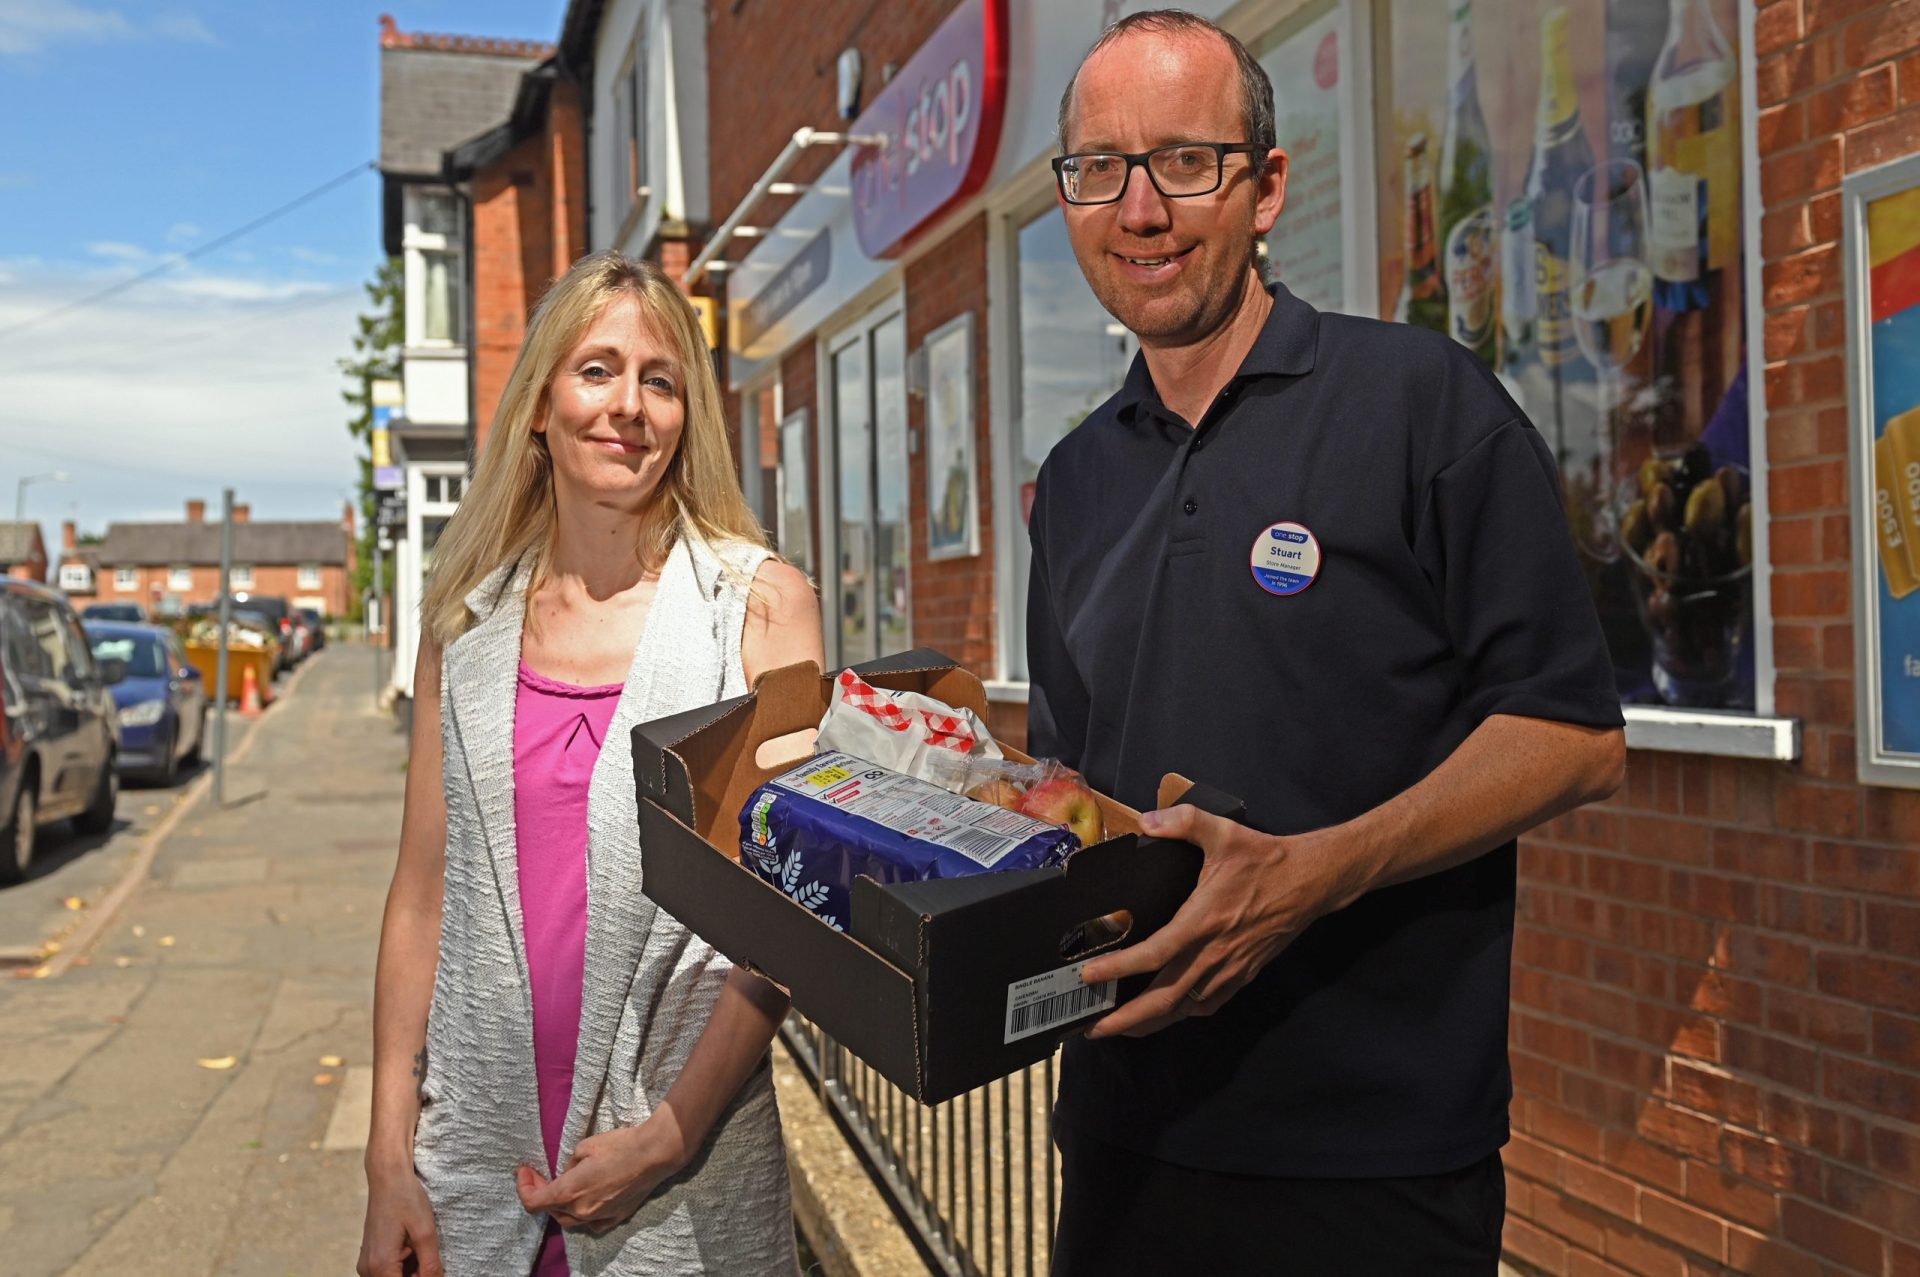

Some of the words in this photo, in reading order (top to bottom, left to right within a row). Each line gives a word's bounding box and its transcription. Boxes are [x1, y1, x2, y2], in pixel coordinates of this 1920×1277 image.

[904, 58, 971, 177] stop
[1288, 533, 1304, 542] stop
[1270, 546, 1302, 560] Stuart
